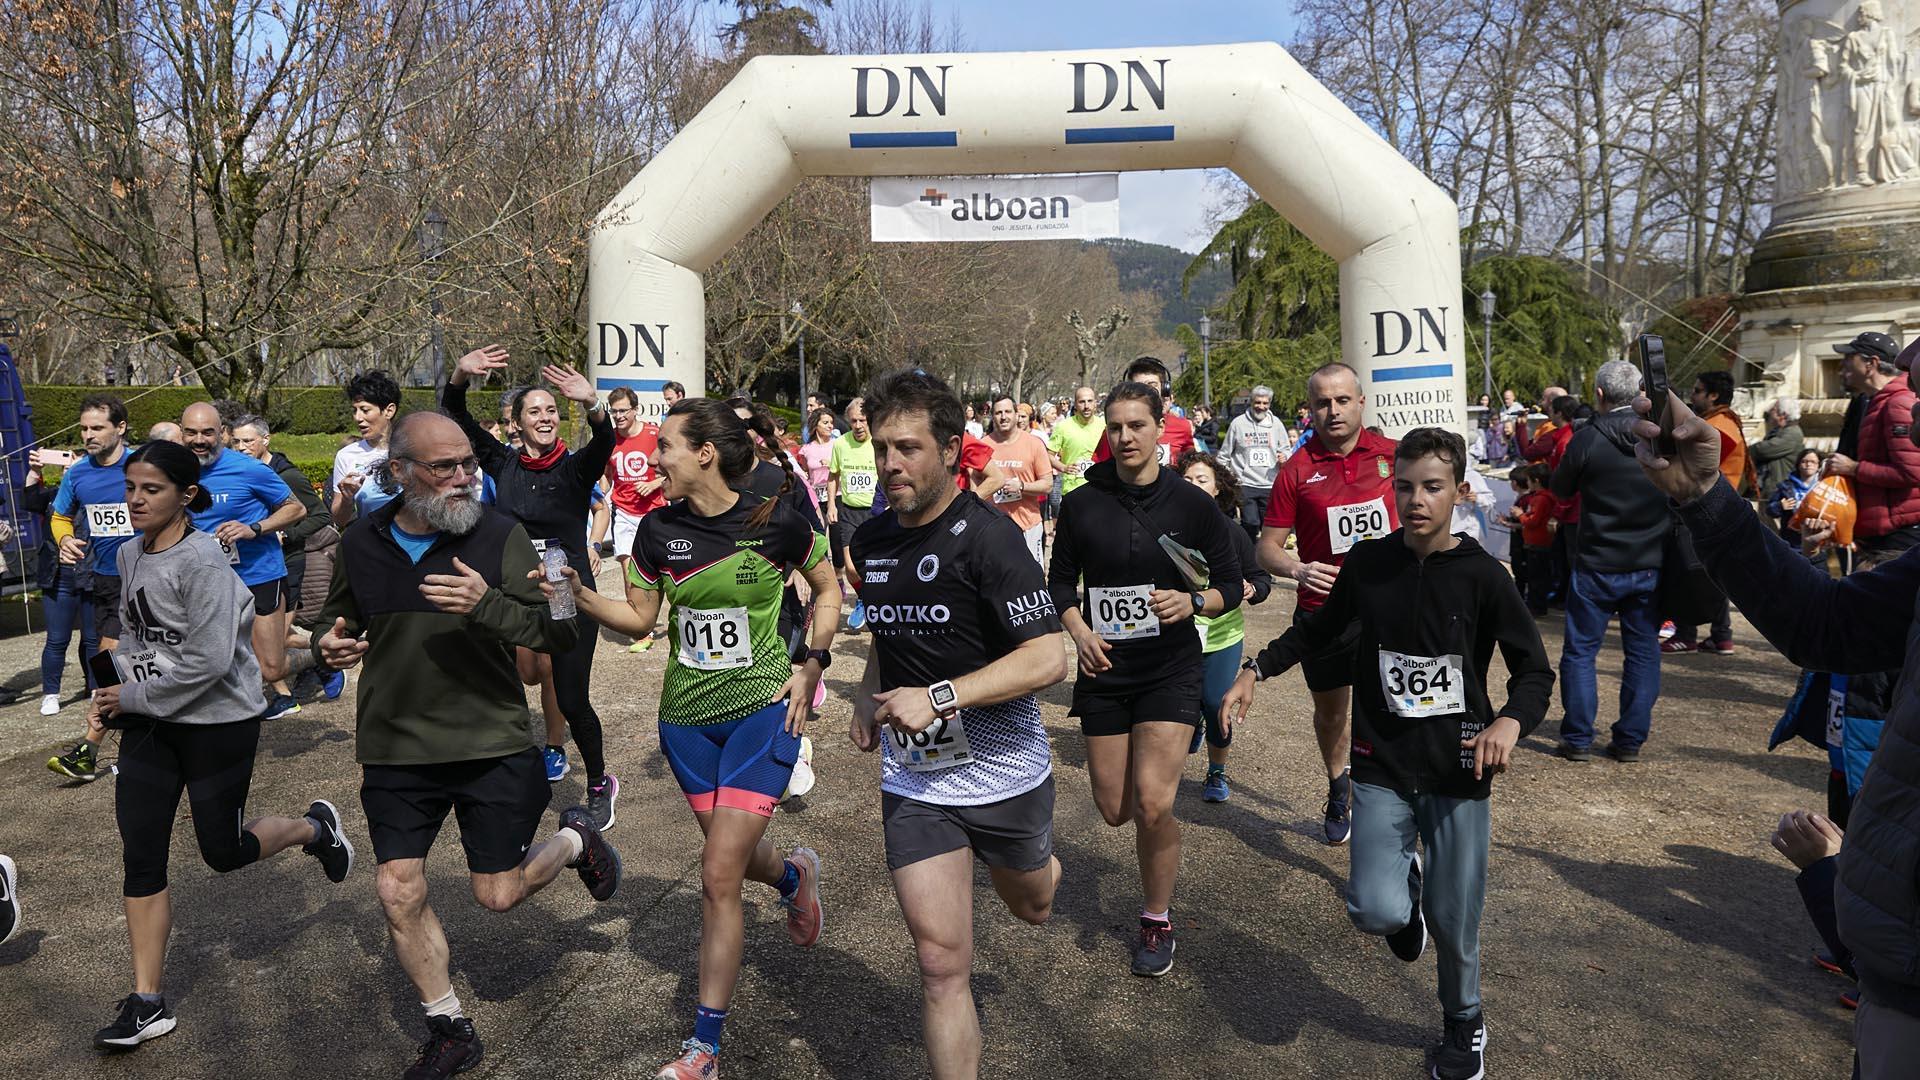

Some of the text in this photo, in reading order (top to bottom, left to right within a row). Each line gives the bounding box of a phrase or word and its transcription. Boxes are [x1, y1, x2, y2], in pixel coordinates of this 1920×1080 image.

[850, 65, 953, 118] DN
[1067, 59, 1172, 114] DN
[951, 192, 1070, 222] alboan
[991, 224, 1005, 232] ONG
[1008, 224, 1033, 232] JESUITA
[1369, 306, 1449, 358] DN
[596, 322, 670, 368] DN
[1375, 388, 1454, 408] DIARIO DE
[1377, 408, 1455, 428] NAVARRA
[611, 450, 649, 477] 10
[850, 475, 871, 486] 080
[93, 510, 126, 526] 056
[1348, 504, 1374, 514] alboan
[1338, 510, 1383, 537] 050
[670, 542, 689, 551] KIA
[865, 571, 890, 583] 226ERS
[1108, 589, 1137, 598] alboan
[693, 612, 725, 622] alboan
[865, 603, 951, 624] GOIZKO
[1099, 596, 1149, 623] 063
[684, 620, 739, 650] 018
[132, 661, 163, 683] 05
[1402, 659, 1438, 669] alboan
[1387, 665, 1452, 696] 364
